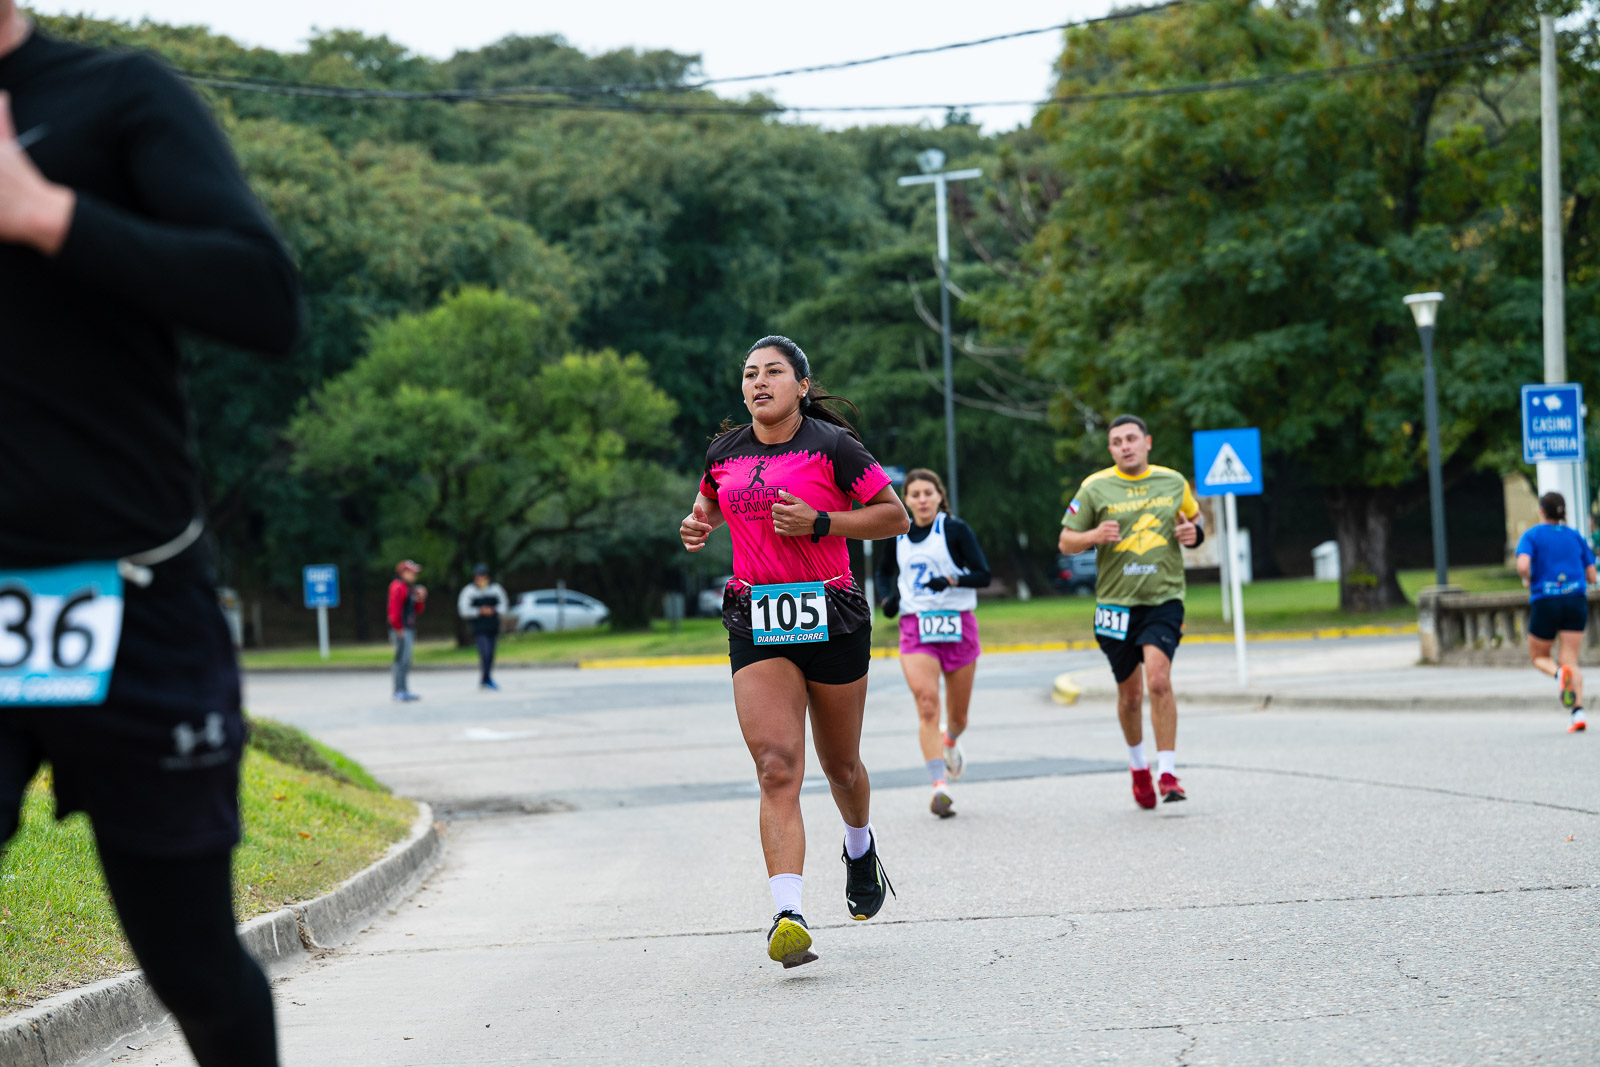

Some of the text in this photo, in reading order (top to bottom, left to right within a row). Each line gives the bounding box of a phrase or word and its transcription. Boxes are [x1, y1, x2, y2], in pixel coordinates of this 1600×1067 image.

[1532, 416, 1573, 433] CASINO
[1528, 437, 1578, 452] VICTORIA
[1107, 496, 1174, 515] ANIVERSARIO
[757, 592, 820, 632] 105
[1097, 608, 1122, 631] 031
[0, 588, 95, 668] 36
[923, 615, 957, 634] 025
[757, 632, 825, 643] DIAMANTE CORRE
